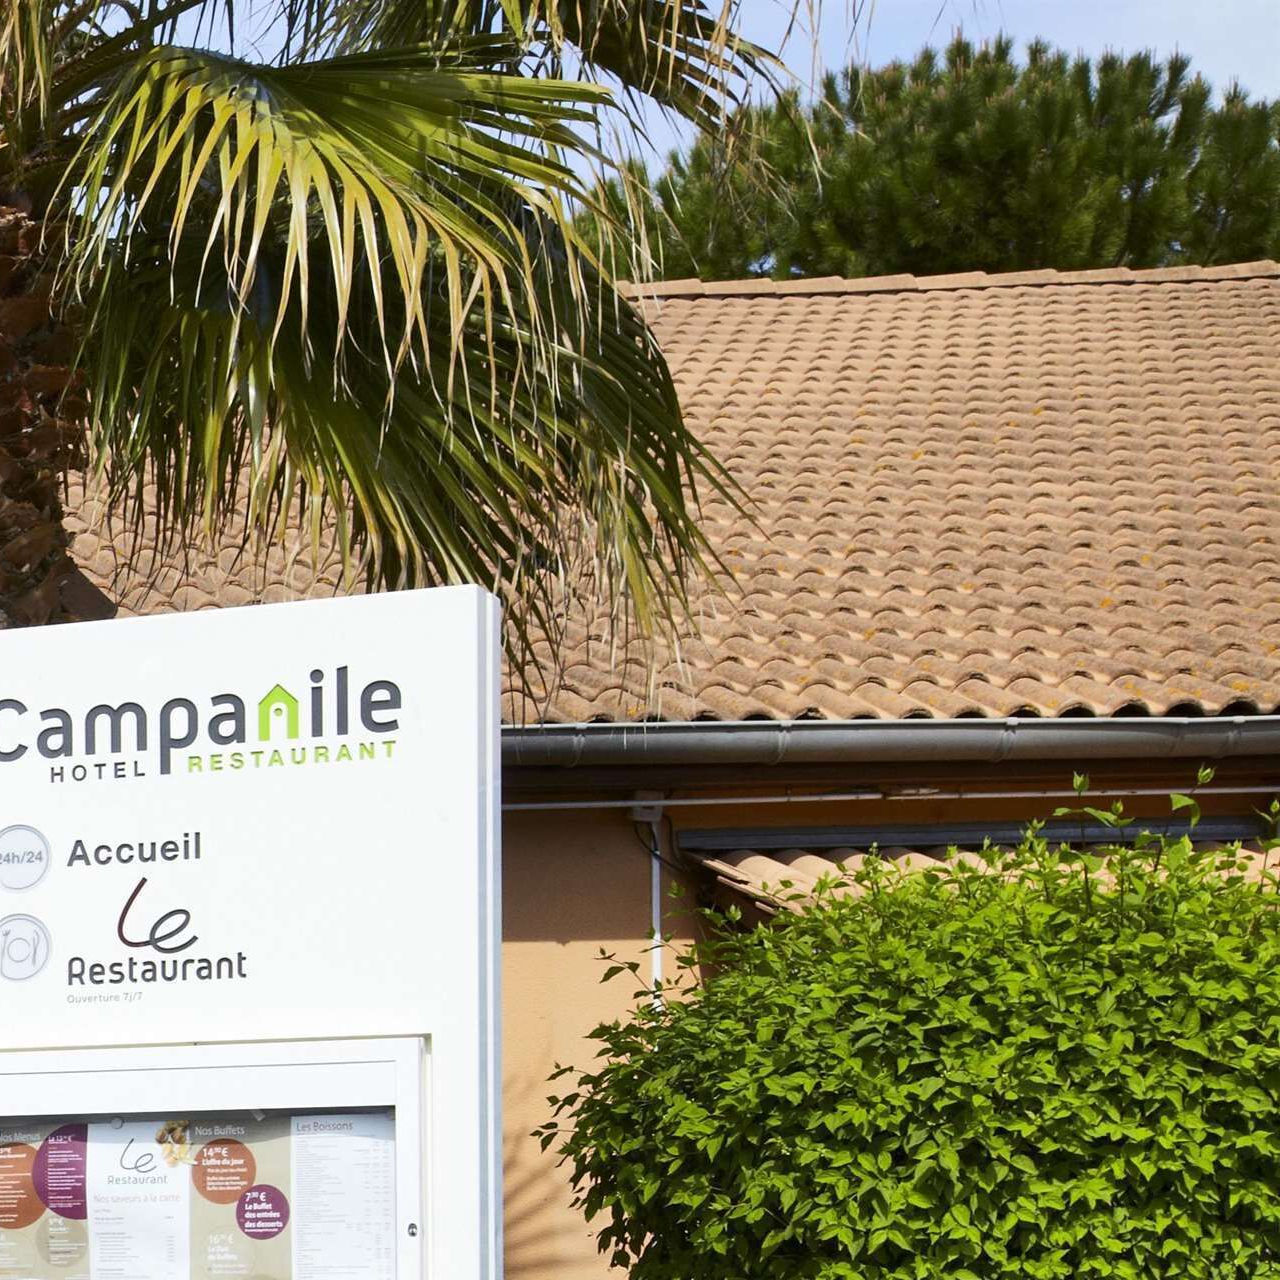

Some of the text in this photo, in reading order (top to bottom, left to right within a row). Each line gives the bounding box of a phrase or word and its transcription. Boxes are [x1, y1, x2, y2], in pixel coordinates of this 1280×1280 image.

[49, 740, 398, 783] HOTEL RESTAURANT
[66, 832, 202, 867] Accueil
[117, 876, 199, 954] Le
[67, 951, 248, 986] Restaurant
[66, 993, 120, 1004] Ouverture
[194, 1126, 212, 1136] Nos
[296, 1120, 354, 1132] Les Boissons
[107, 1174, 169, 1185] Restaurant
